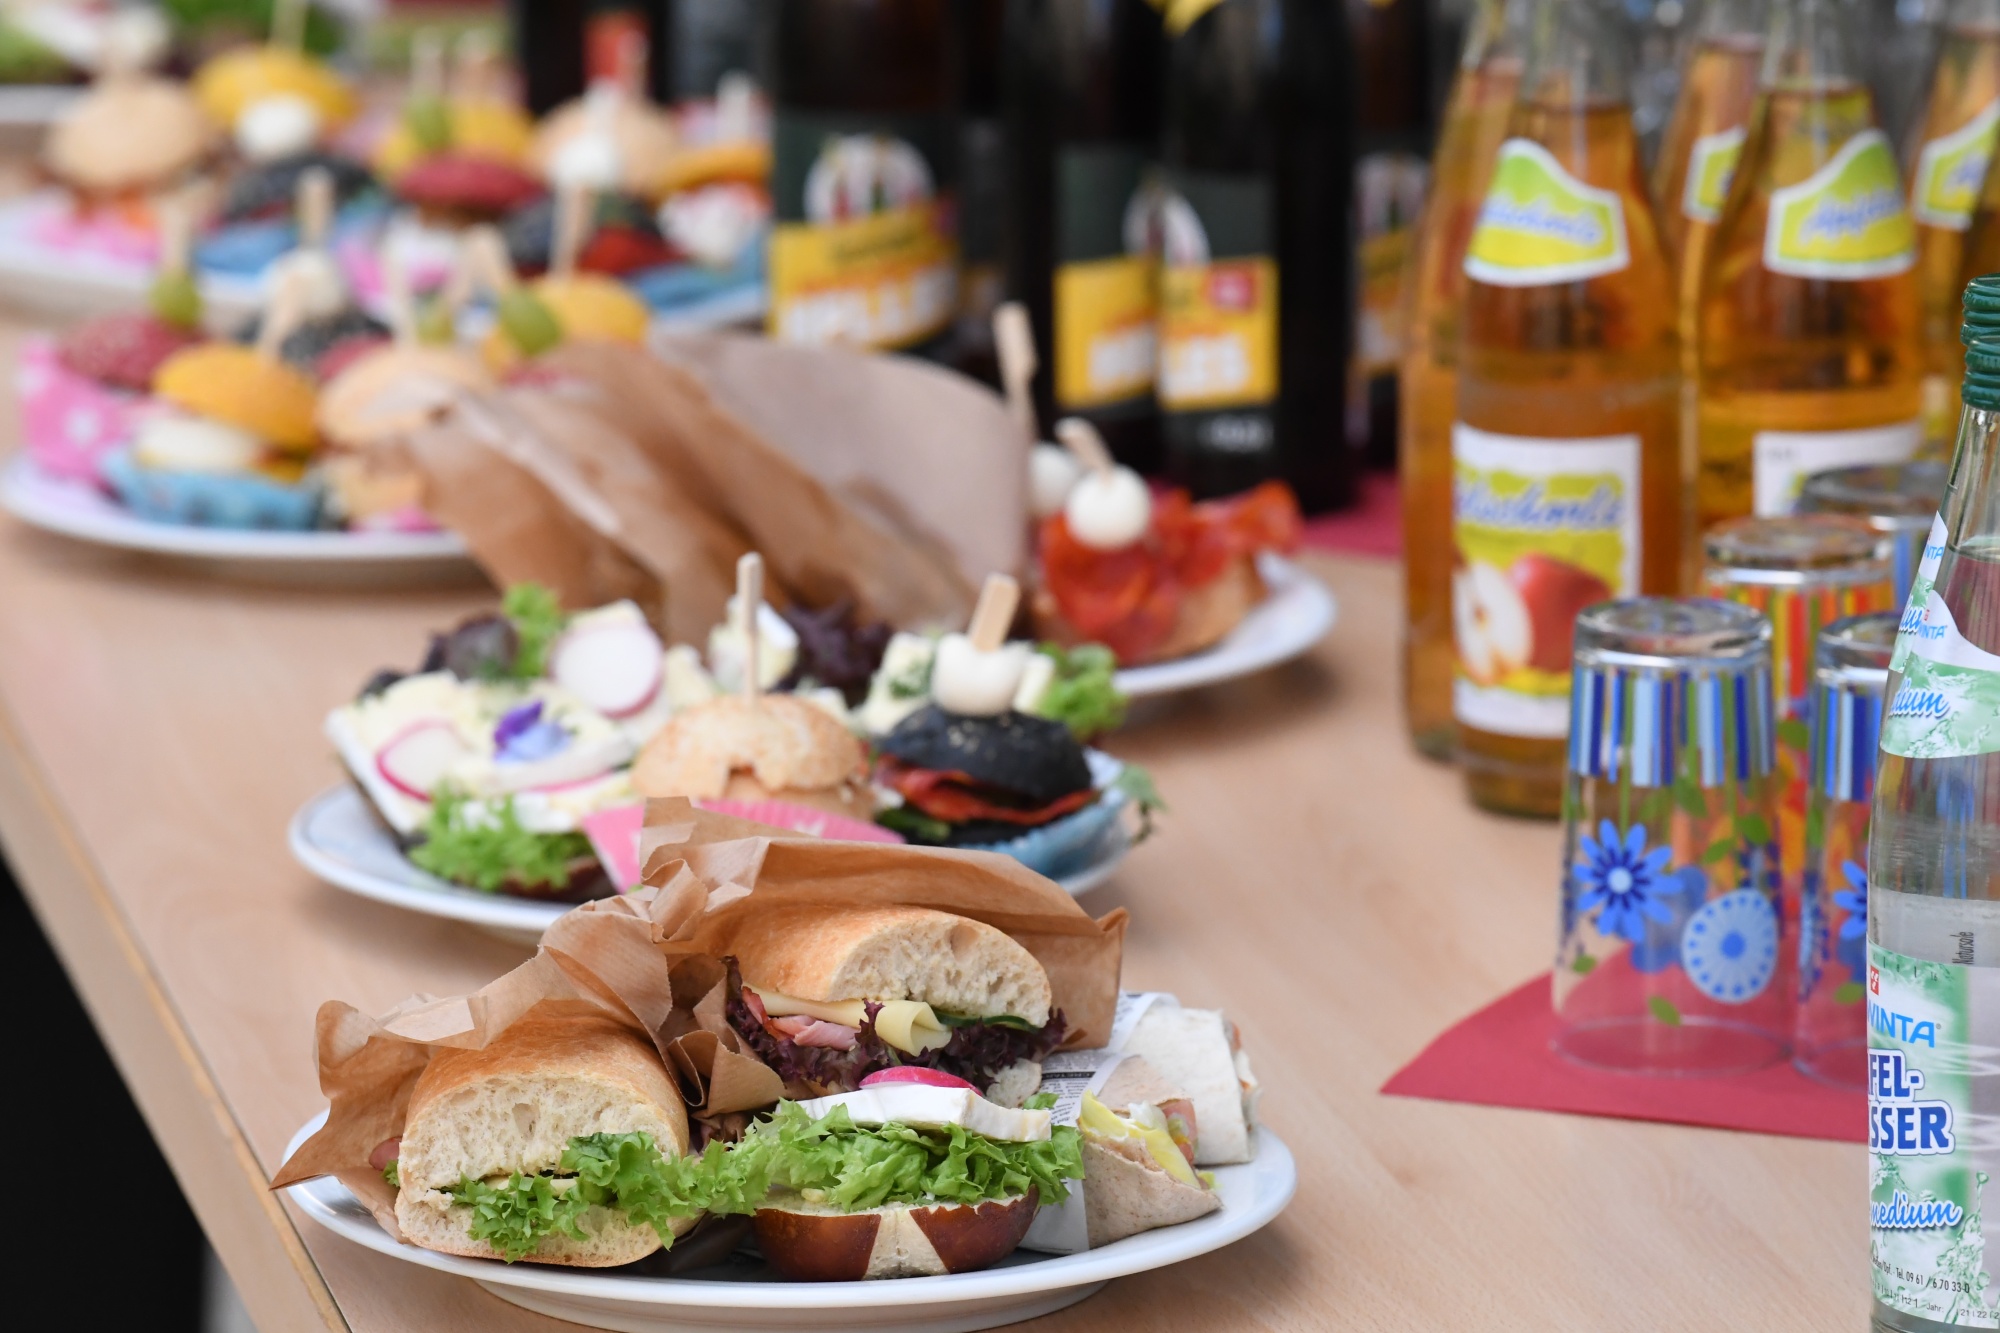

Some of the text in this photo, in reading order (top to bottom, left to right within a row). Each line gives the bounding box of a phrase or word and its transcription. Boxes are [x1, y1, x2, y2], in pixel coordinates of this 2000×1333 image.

[1896, 1267, 1905, 1280] Tel.
[1906, 1271, 1914, 1283] 09
[1915, 1274, 1924, 1285] 61
[1926, 1303, 1944, 1313] Jahr:
[1960, 1308, 1970, 1317] 21
[1977, 1311, 1987, 1319] 22
